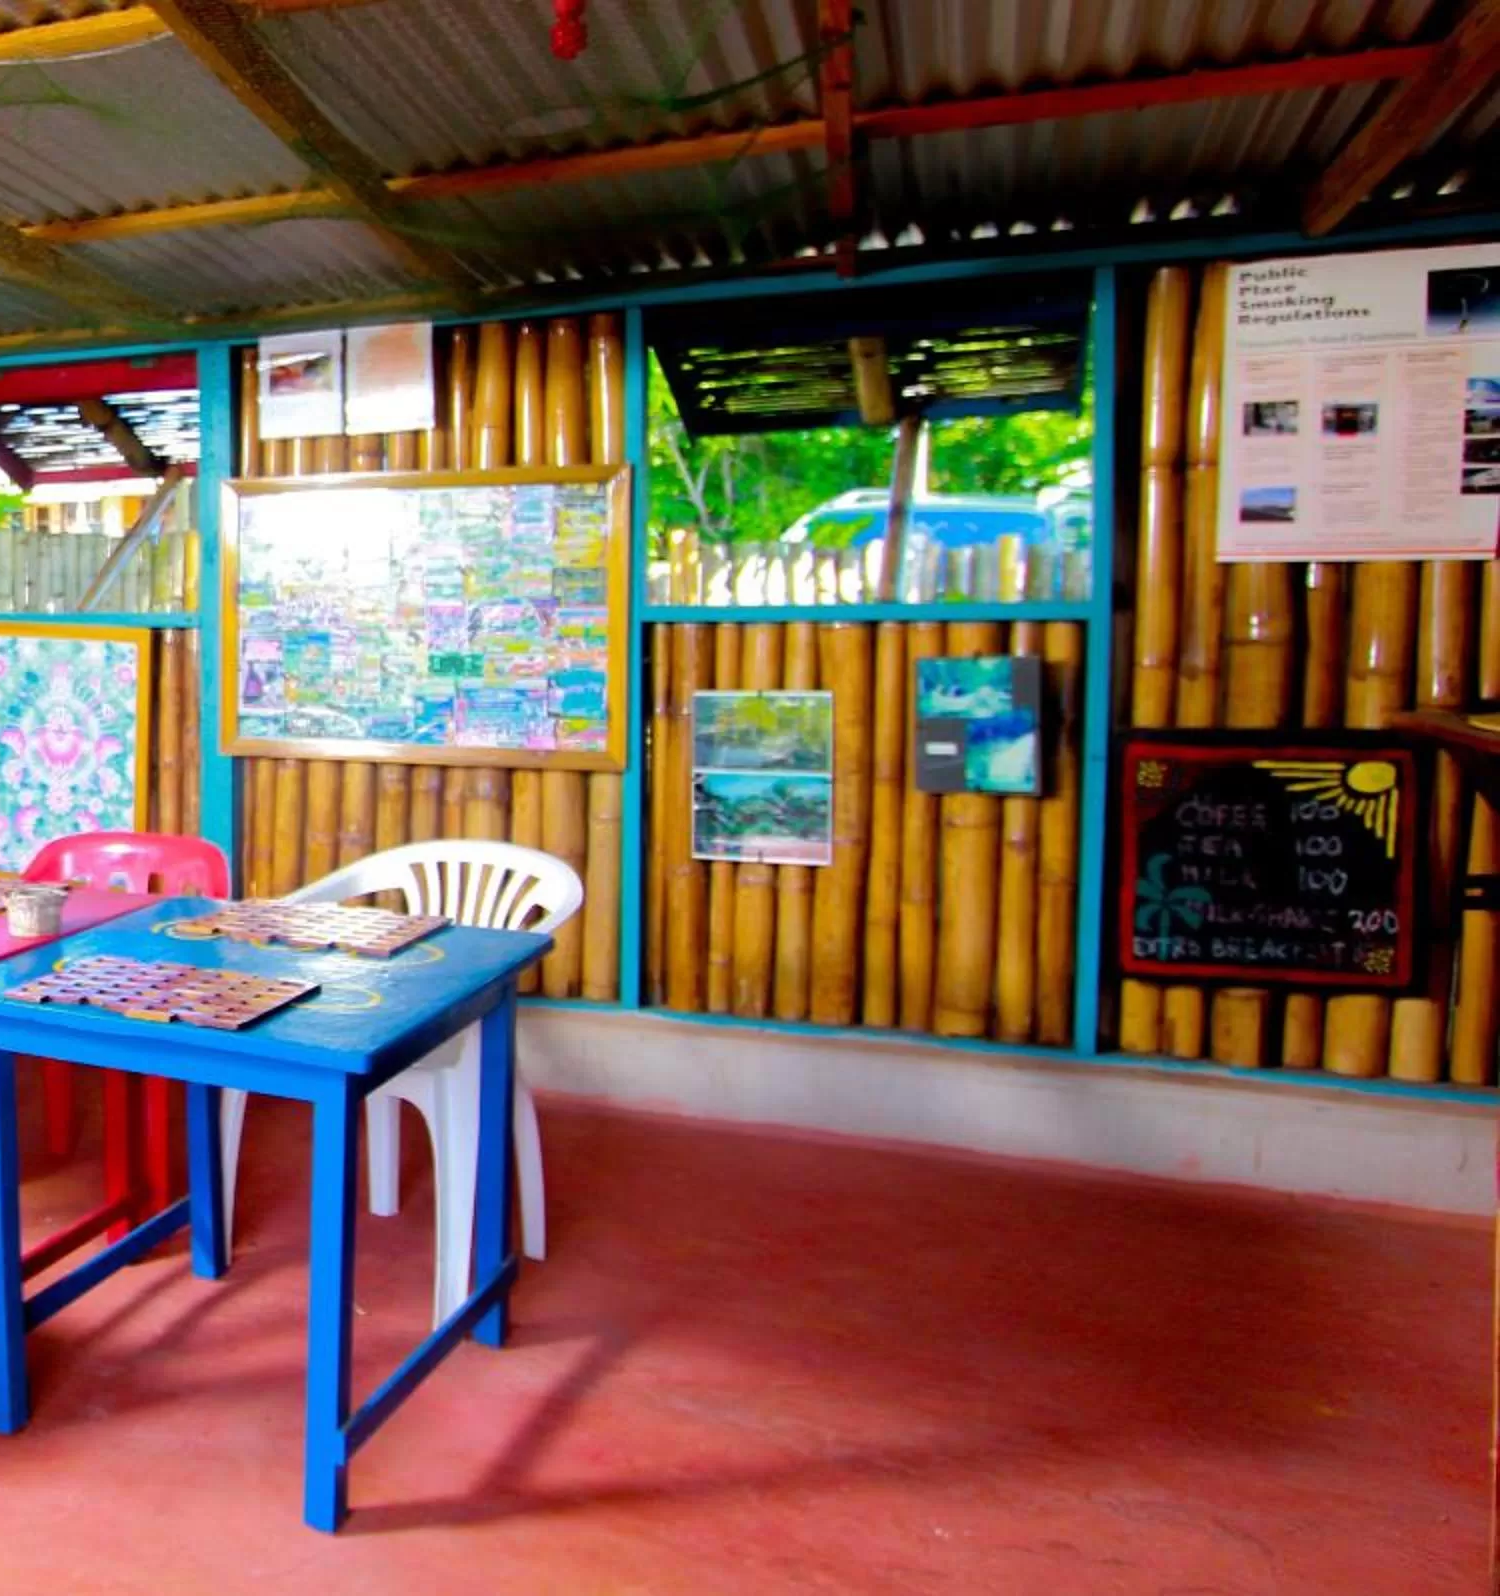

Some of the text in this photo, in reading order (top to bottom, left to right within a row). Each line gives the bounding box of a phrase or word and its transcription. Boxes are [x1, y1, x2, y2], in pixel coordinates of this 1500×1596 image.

[1238, 295, 1336, 310] Smoking
[1237, 308, 1371, 326] Regulations
[1289, 800, 1341, 825] 100
[1295, 834, 1344, 858] 100
[1298, 864, 1349, 897] 100
[1346, 908, 1401, 936] 200
